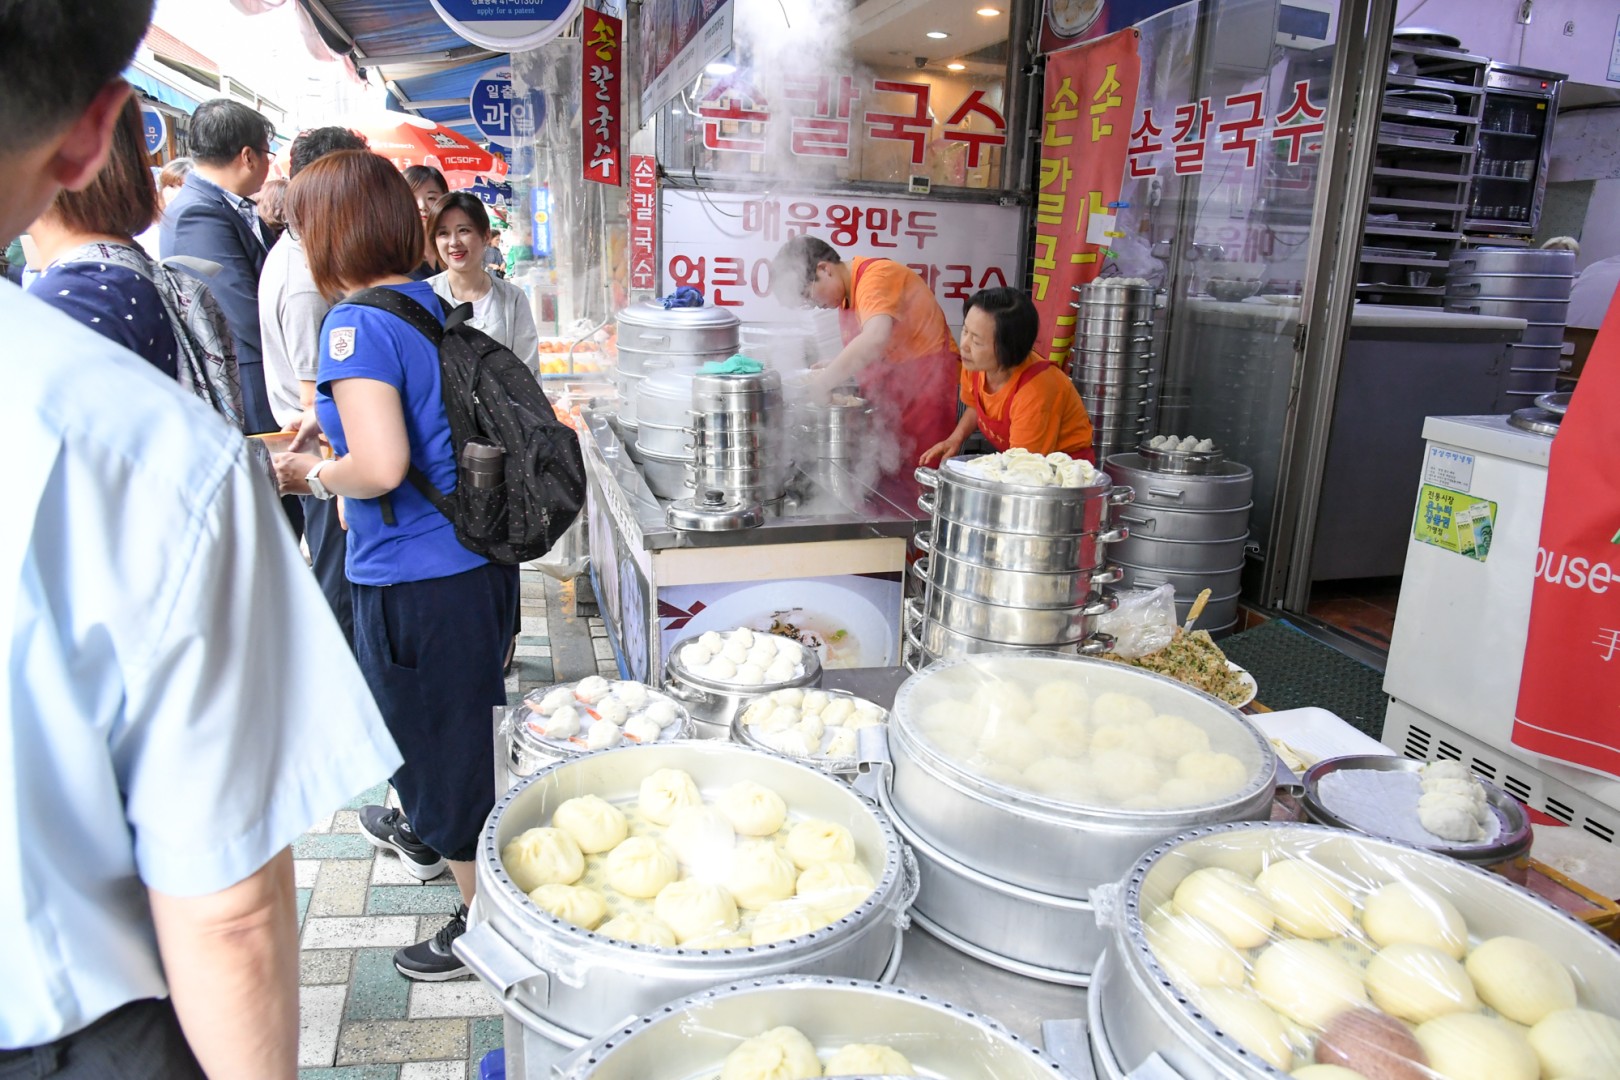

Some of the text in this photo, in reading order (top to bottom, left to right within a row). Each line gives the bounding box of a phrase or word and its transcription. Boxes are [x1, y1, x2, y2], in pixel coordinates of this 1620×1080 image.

[477, 7, 494, 16] apply
[482, 103, 535, 131] 과일
[587, 17, 617, 178] 손칼국수
[698, 68, 1006, 168] 손칼국수
[1128, 79, 1326, 179] 손칼국수
[633, 159, 655, 286] 손칼국수
[742, 200, 938, 250] 매운왕만두
[1427, 490, 1455, 506] 전통시장
[1426, 525, 1443, 536] 가맹점
